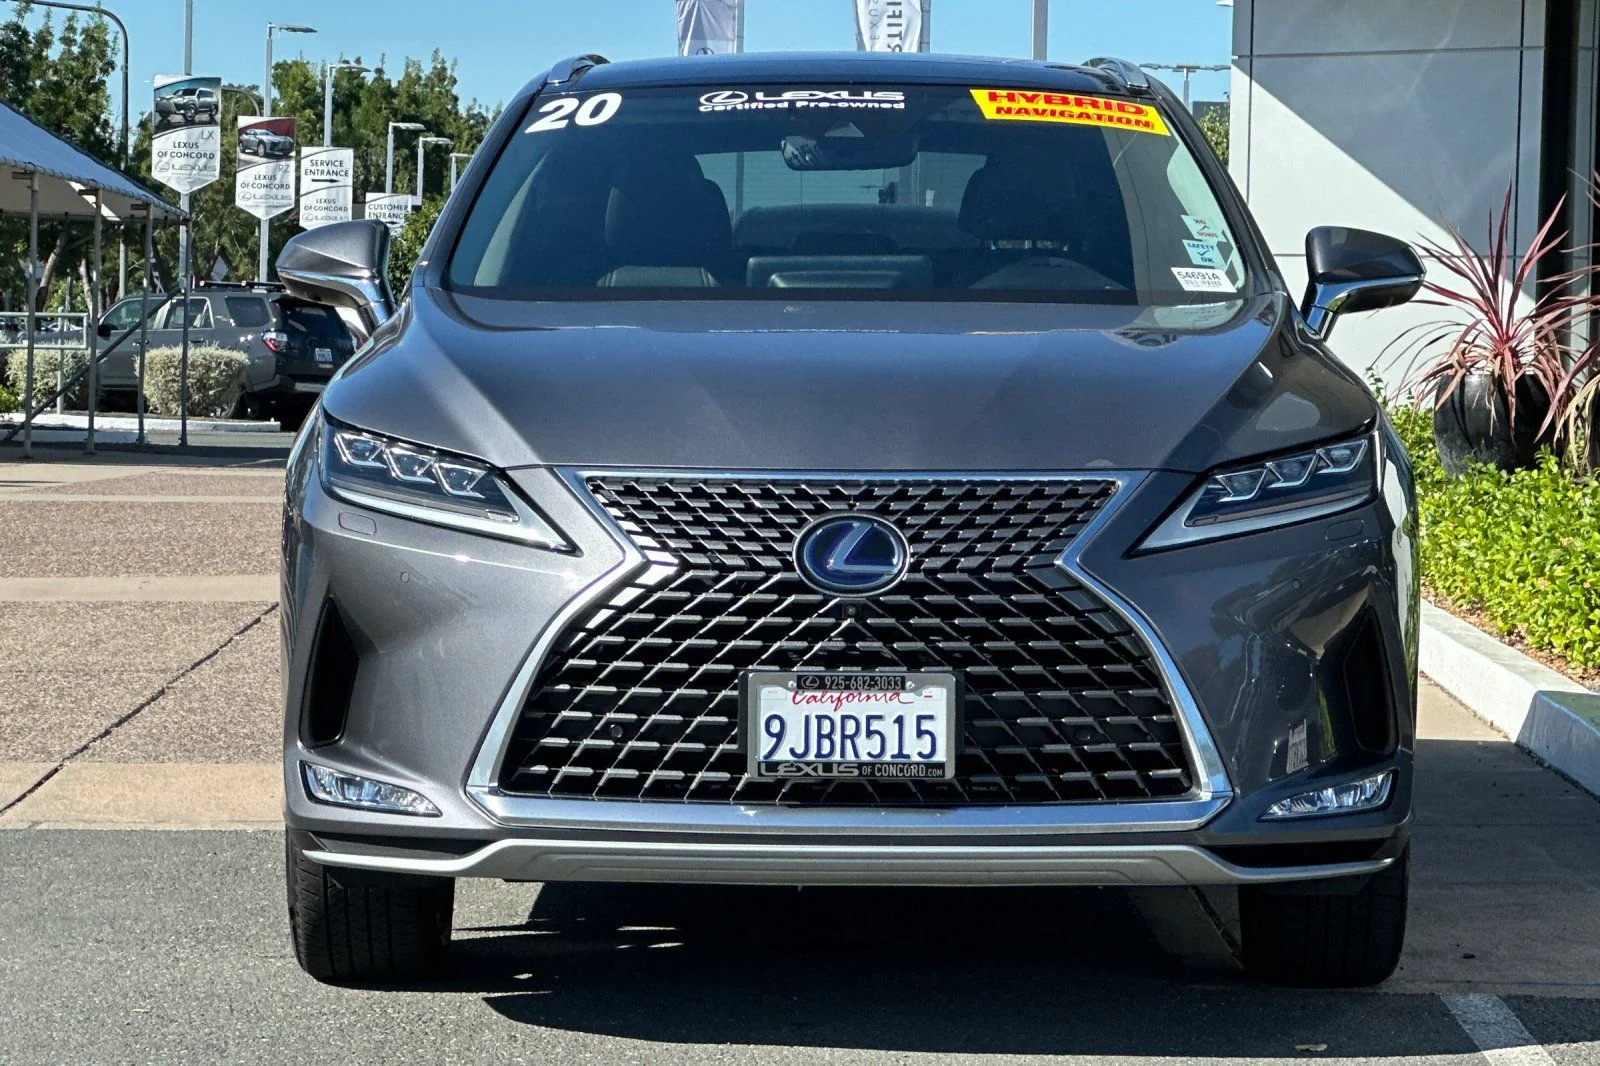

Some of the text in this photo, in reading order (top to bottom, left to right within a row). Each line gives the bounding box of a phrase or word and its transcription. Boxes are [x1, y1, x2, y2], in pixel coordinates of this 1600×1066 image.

[755, 90, 906, 101] LEXUS
[699, 100, 905, 112] Certified Pre-owned
[987, 91, 1148, 117] HYBRID
[524, 92, 623, 134] 20
[995, 106, 1154, 130] NAVIGATION
[201, 130, 215, 140] LX
[173, 141, 200, 149] LEXUS
[170, 151, 215, 160] CONCORD
[310, 159, 344, 168] SERVICE
[304, 168, 350, 177] ENTRANCE
[251, 182, 291, 190] CONCORD
[368, 203, 409, 213] CUSTOMER
[368, 211, 404, 220] ENTRANC
[1177, 271, 1221, 281] 54691A
[824, 675, 902, 690] 925-682-3033
[791, 690, 915, 711] California
[763, 713, 938, 761] 9JBR515
[760, 762, 860, 777] LEXUS
[861, 765, 873, 776] OF
